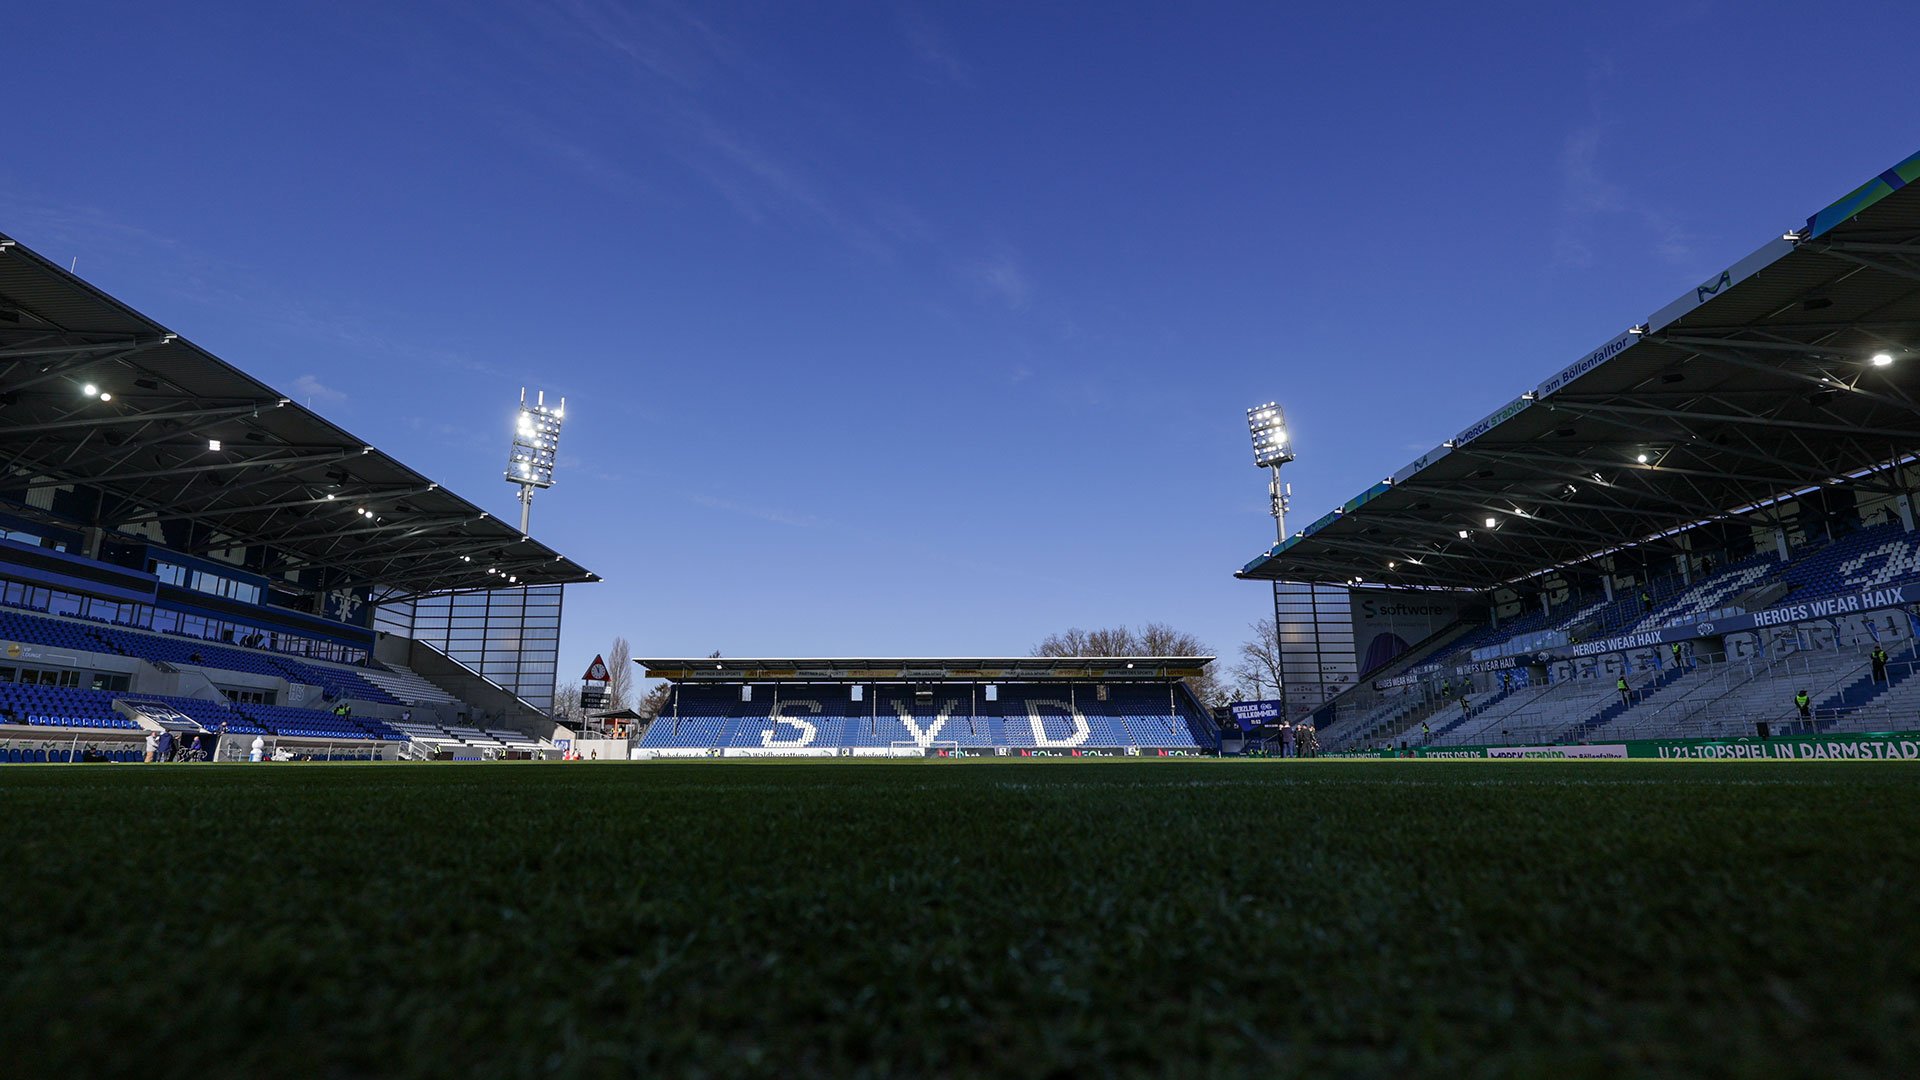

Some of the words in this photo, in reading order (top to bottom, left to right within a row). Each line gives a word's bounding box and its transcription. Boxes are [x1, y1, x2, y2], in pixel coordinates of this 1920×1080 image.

[1545, 378, 1560, 393] am
[1562, 336, 1628, 383] Böllenfalltor
[1380, 603, 1442, 616] software
[1754, 605, 1808, 627] HEROES
[1811, 595, 1860, 617] WEAR
[1861, 587, 1905, 609] HAIX
[1573, 640, 1606, 657] HEROES
[1607, 636, 1636, 651] WEAR
[1638, 631, 1663, 647] HAIX
[1480, 659, 1500, 672] WEAR
[1500, 656, 1517, 669] HAIX
[1232, 704, 1258, 713] HERZLICH
[1237, 709, 1277, 719] WILLKOMMEN!
[1658, 746, 1669, 759] U
[1673, 744, 1772, 759] 21-TOPSPIEL
[1774, 743, 1795, 759] IN
